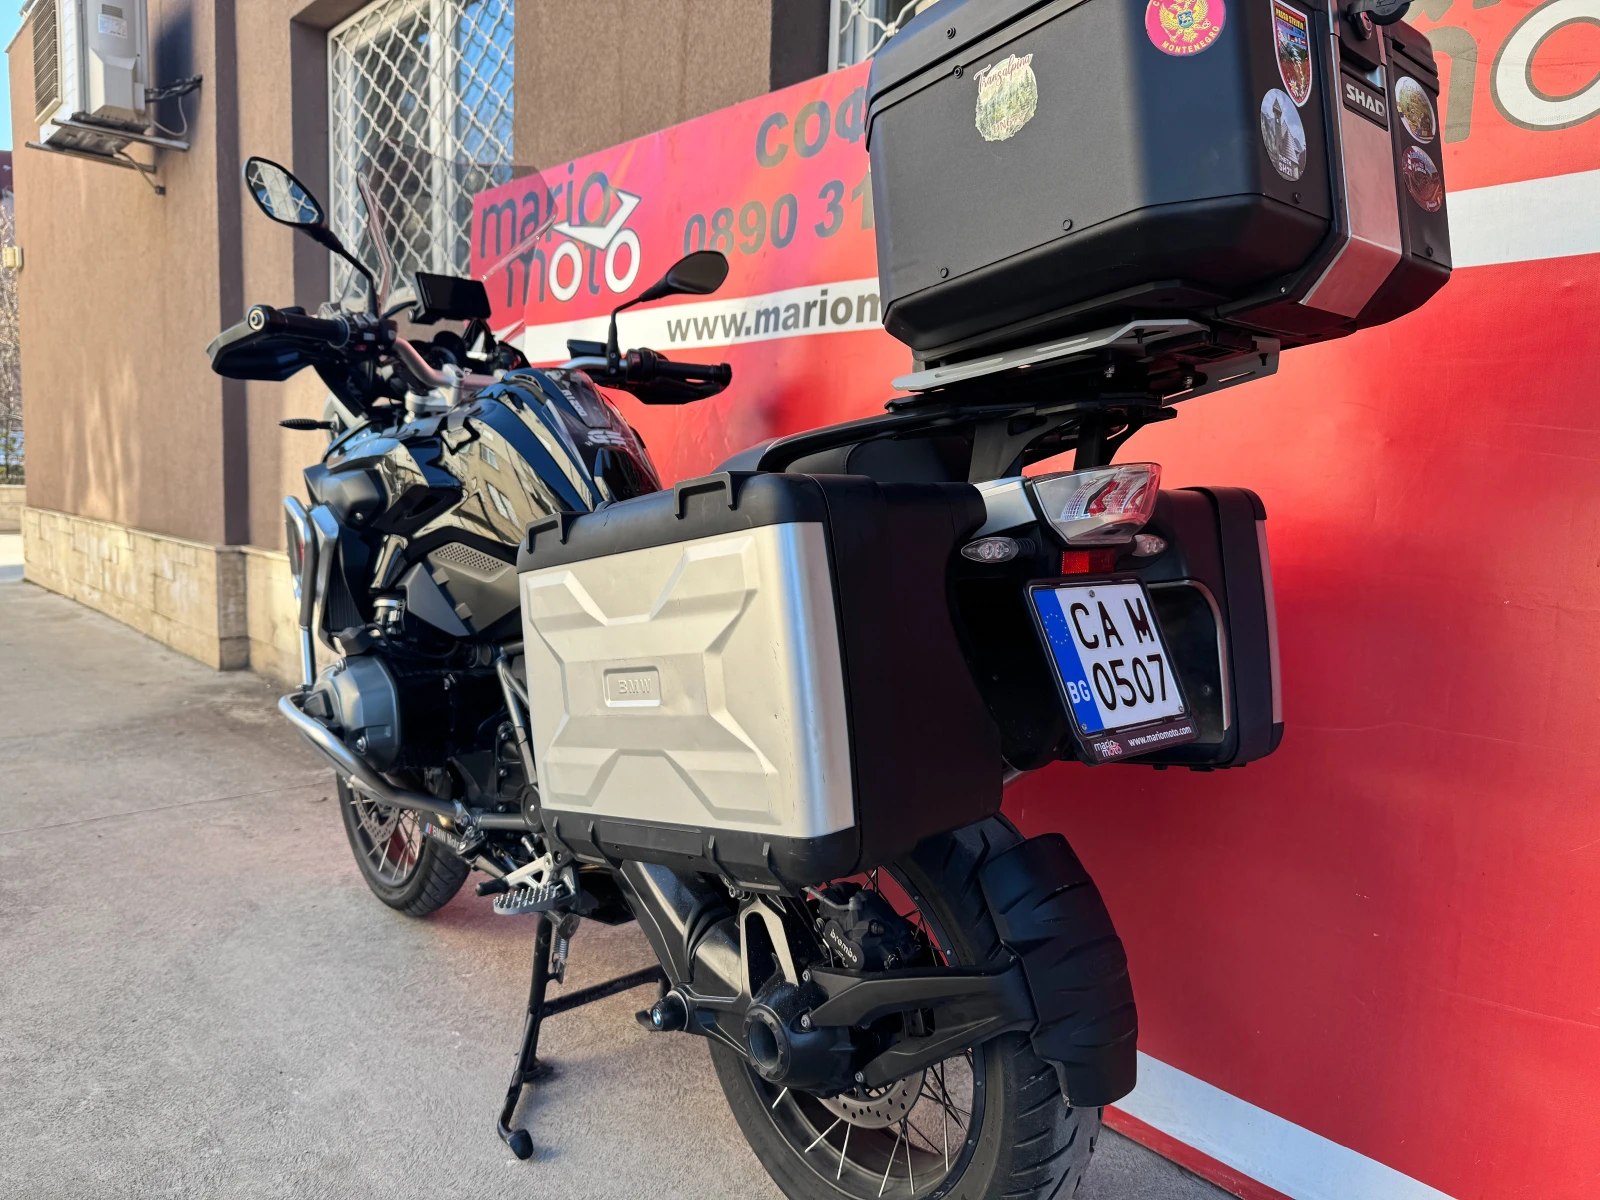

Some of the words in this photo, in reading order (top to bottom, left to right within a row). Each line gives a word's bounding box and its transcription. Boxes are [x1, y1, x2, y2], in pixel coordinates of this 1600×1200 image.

[1161, 26, 1220, 53] MONTENEGRO
[974, 54, 1033, 93] Transalpina
[1345, 83, 1386, 117] SHAD
[480, 162, 612, 259] mario
[683, 193, 798, 258] 0890
[814, 171, 875, 239] 31
[506, 226, 641, 308] moto
[1070, 600, 1125, 650] CA
[1123, 597, 1156, 644] M
[618, 678, 651, 694] BMW
[1066, 679, 1092, 704] BG
[1092, 653, 1167, 711] 0507
[1094, 739, 1117, 752] mario
[1102, 745, 1122, 758] moto
[1128, 725, 1192, 747] www.mariomoto.com
[432, 825, 446, 841] BMW
[830, 928, 857, 963] brembo
